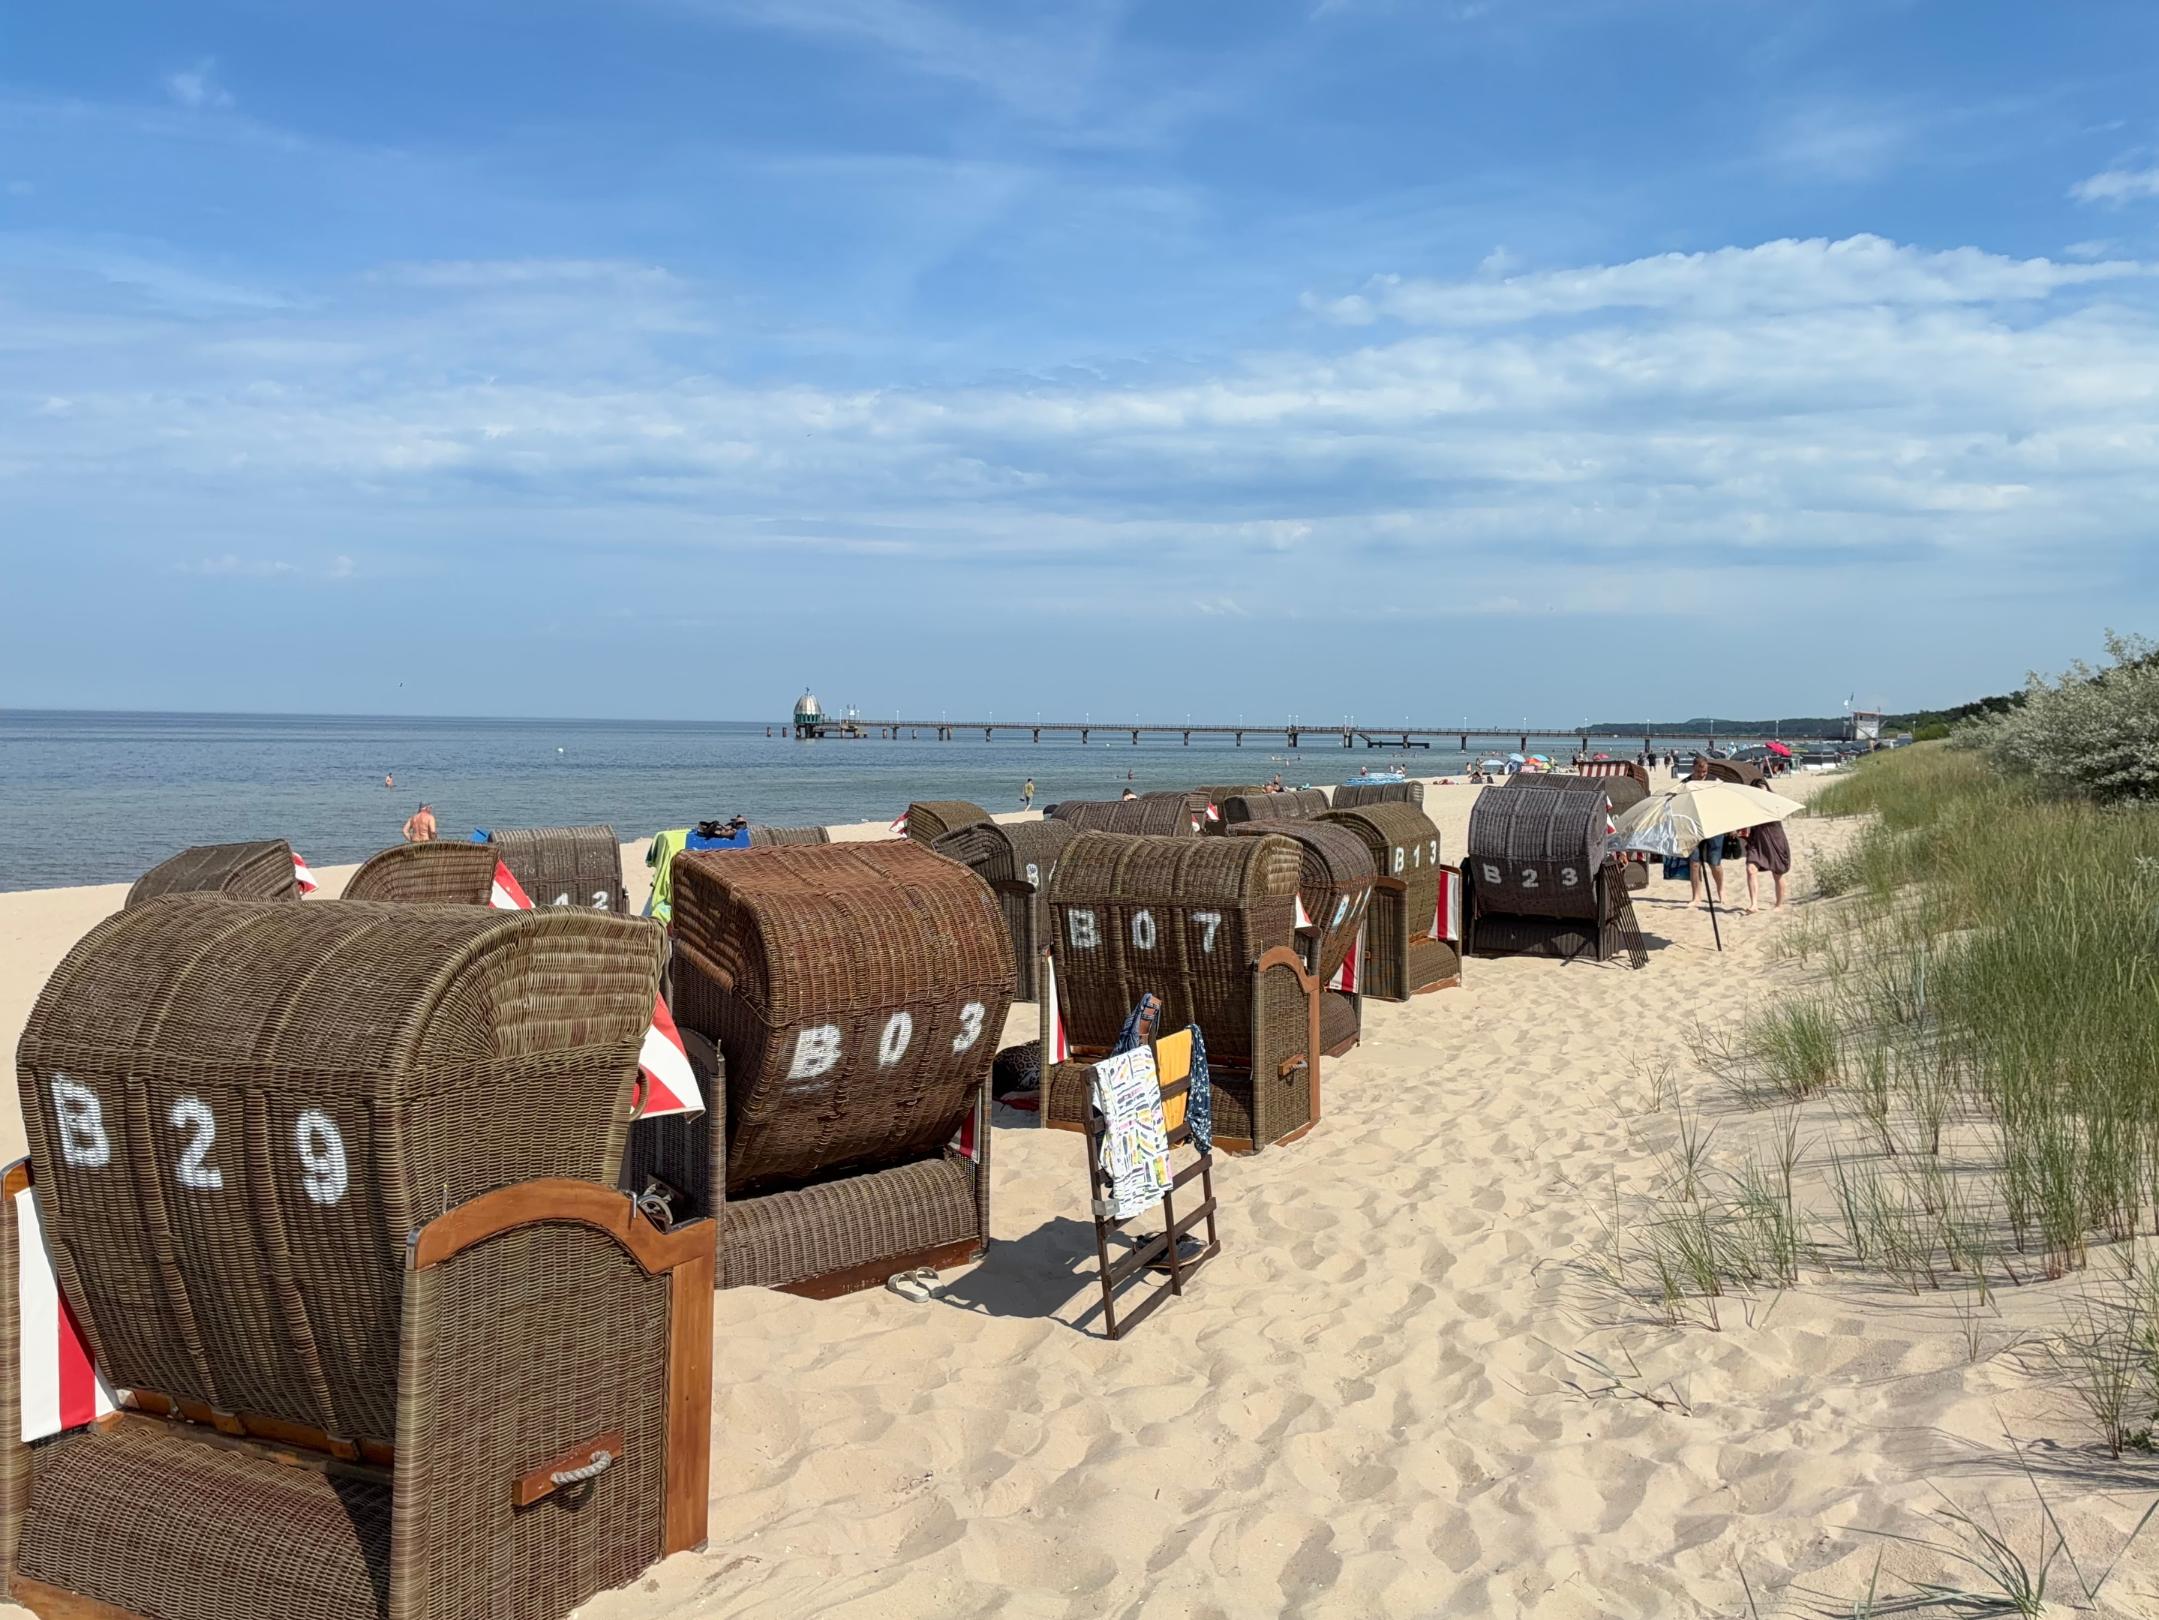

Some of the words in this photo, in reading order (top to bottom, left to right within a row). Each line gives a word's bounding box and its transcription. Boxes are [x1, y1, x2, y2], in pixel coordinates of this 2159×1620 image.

[1394, 840, 1437, 873] B13
[1483, 862, 1579, 888] B23
[1068, 908, 1221, 953] B07
[787, 1001, 986, 1080] B03
[51, 1073, 348, 1204] B29
